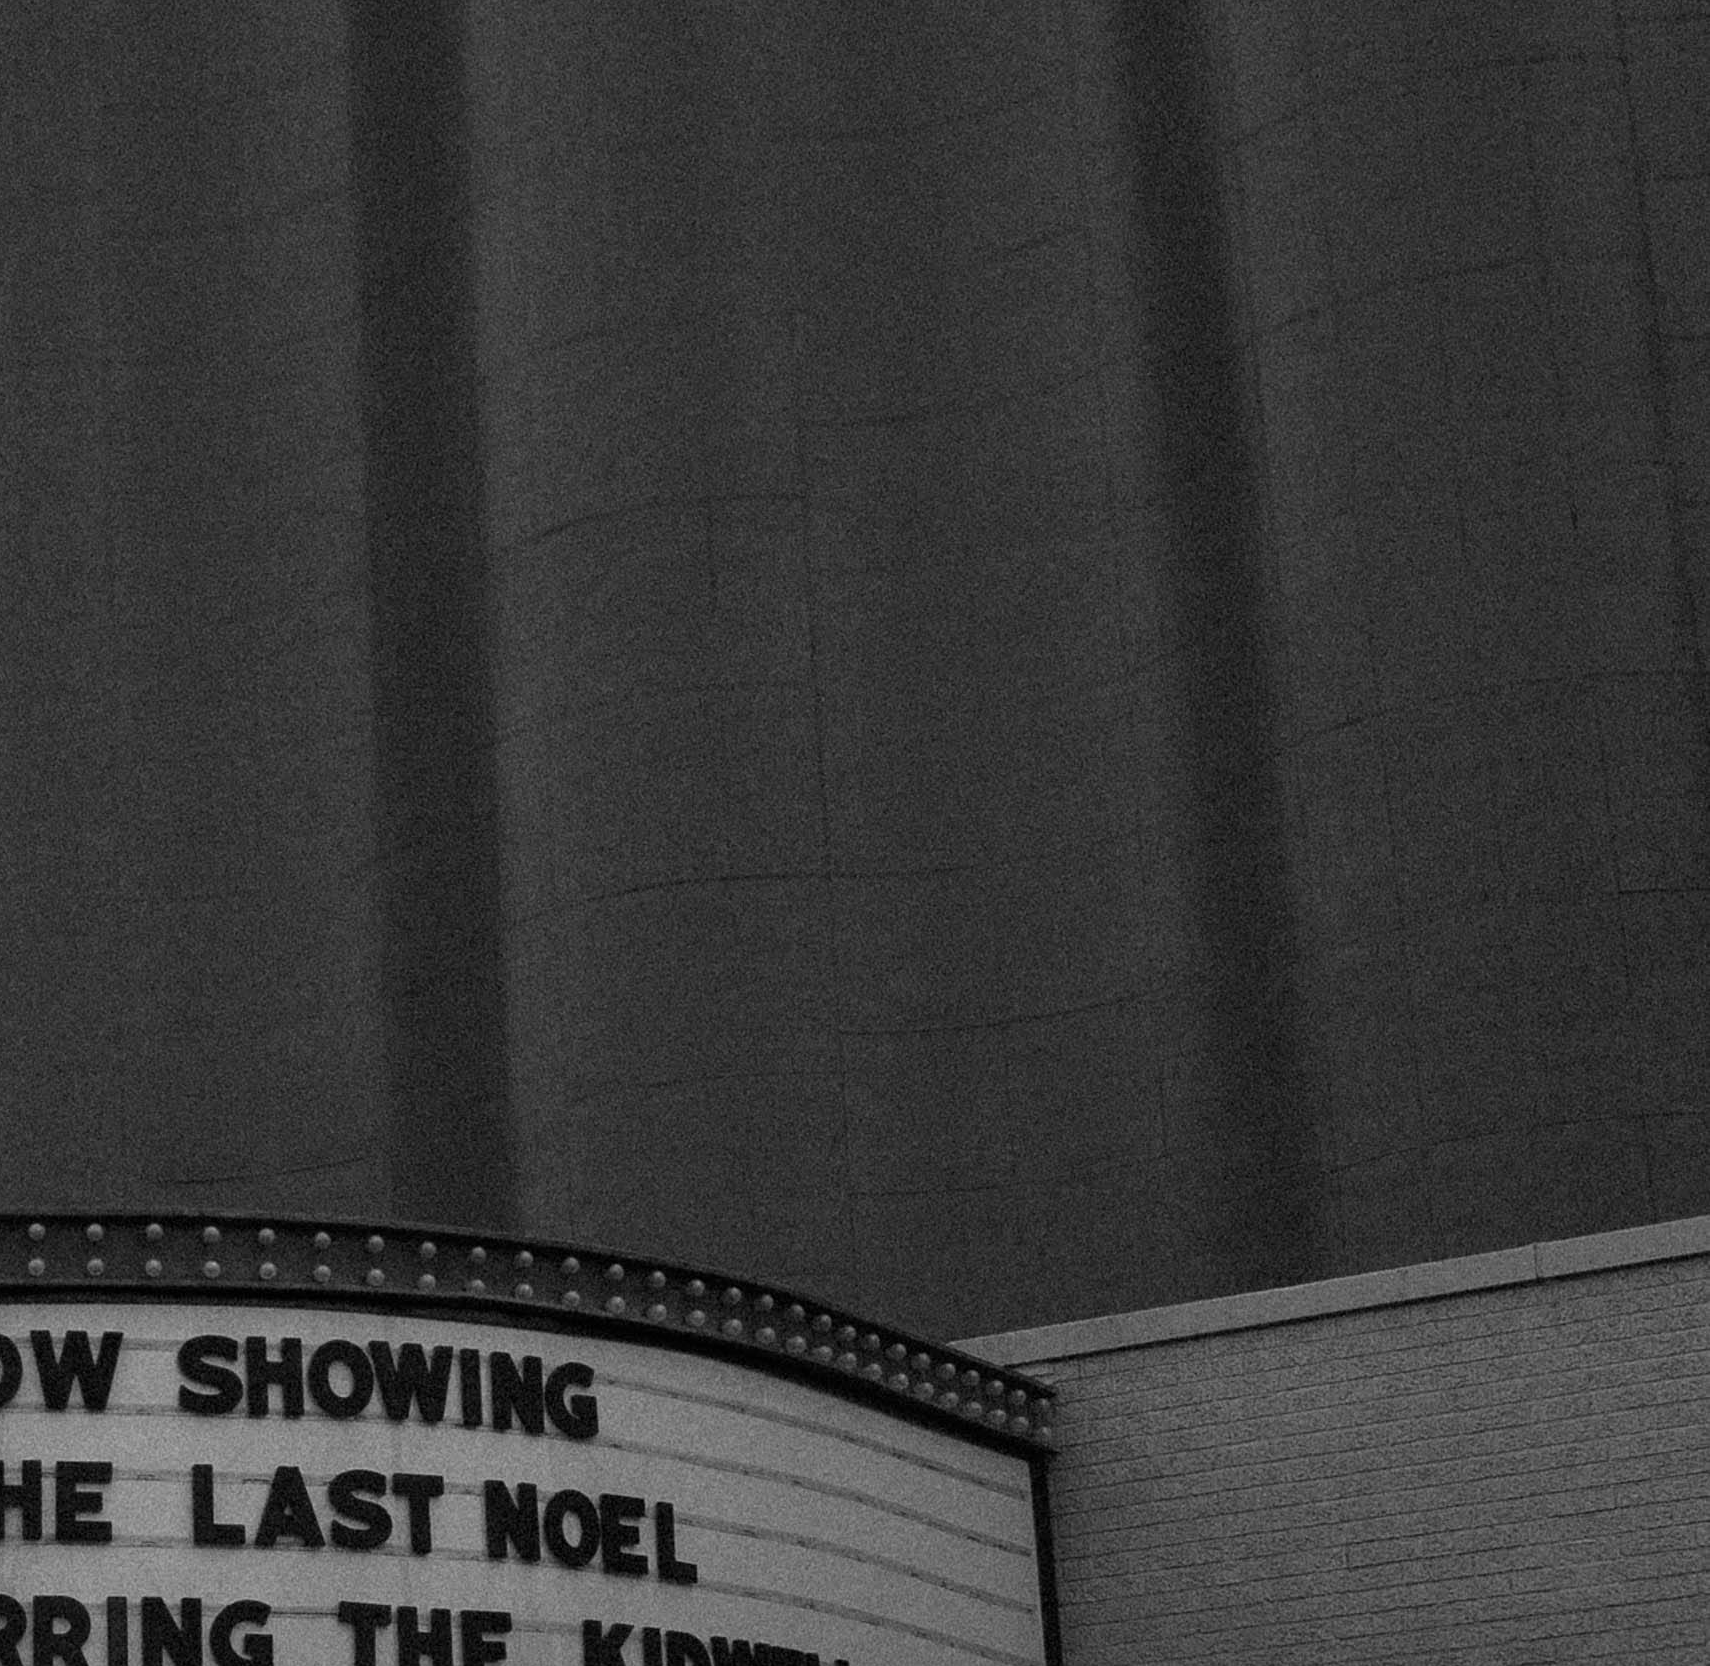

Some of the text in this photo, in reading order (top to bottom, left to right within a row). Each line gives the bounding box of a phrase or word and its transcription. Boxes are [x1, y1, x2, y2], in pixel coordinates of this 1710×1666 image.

[176, 1334, 599, 1438] SHOWING
[192, 1464, 444, 1556] LAST
[483, 1479, 698, 1584] NOEL
